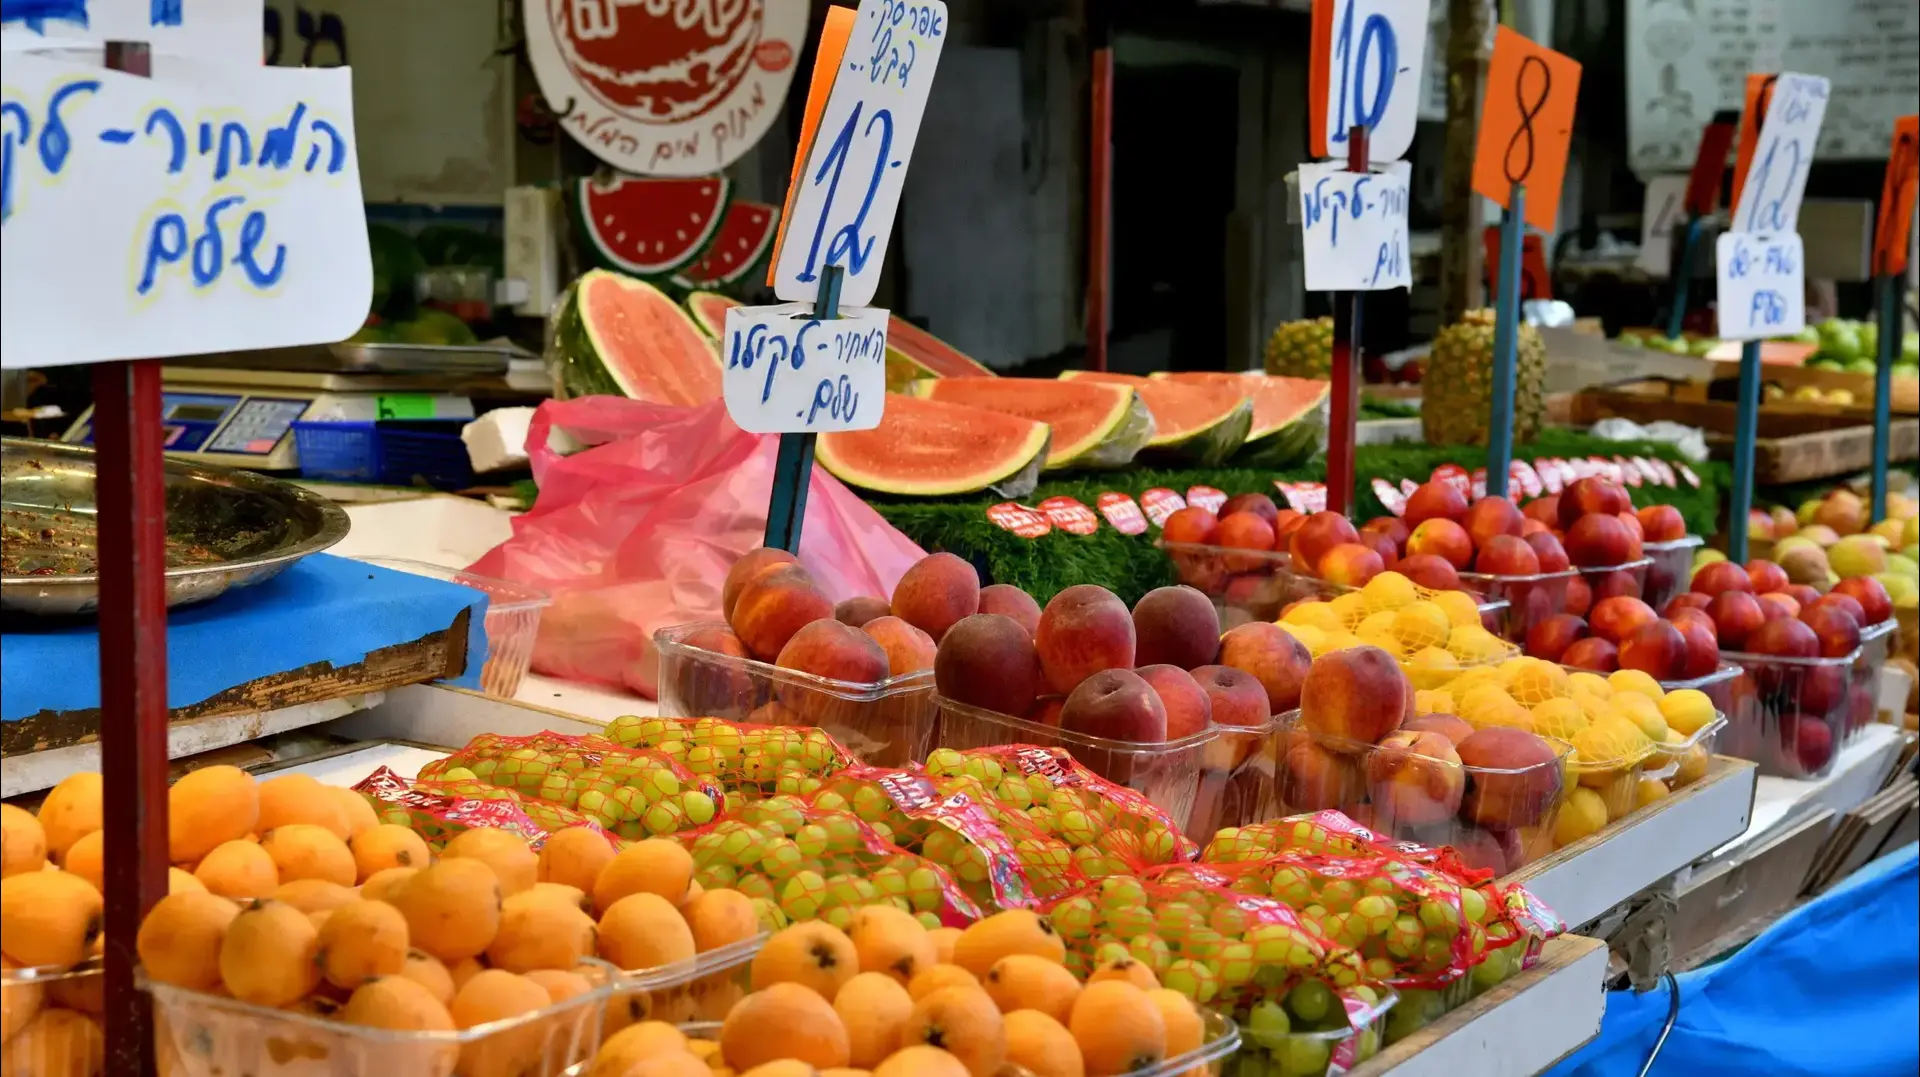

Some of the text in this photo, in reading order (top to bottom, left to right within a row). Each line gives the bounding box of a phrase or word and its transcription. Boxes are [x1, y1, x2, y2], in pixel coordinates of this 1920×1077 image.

[137, 195, 287, 295] שלם
[728, 320, 821, 405] לקילו
[835, 327, 884, 364] המחיר
